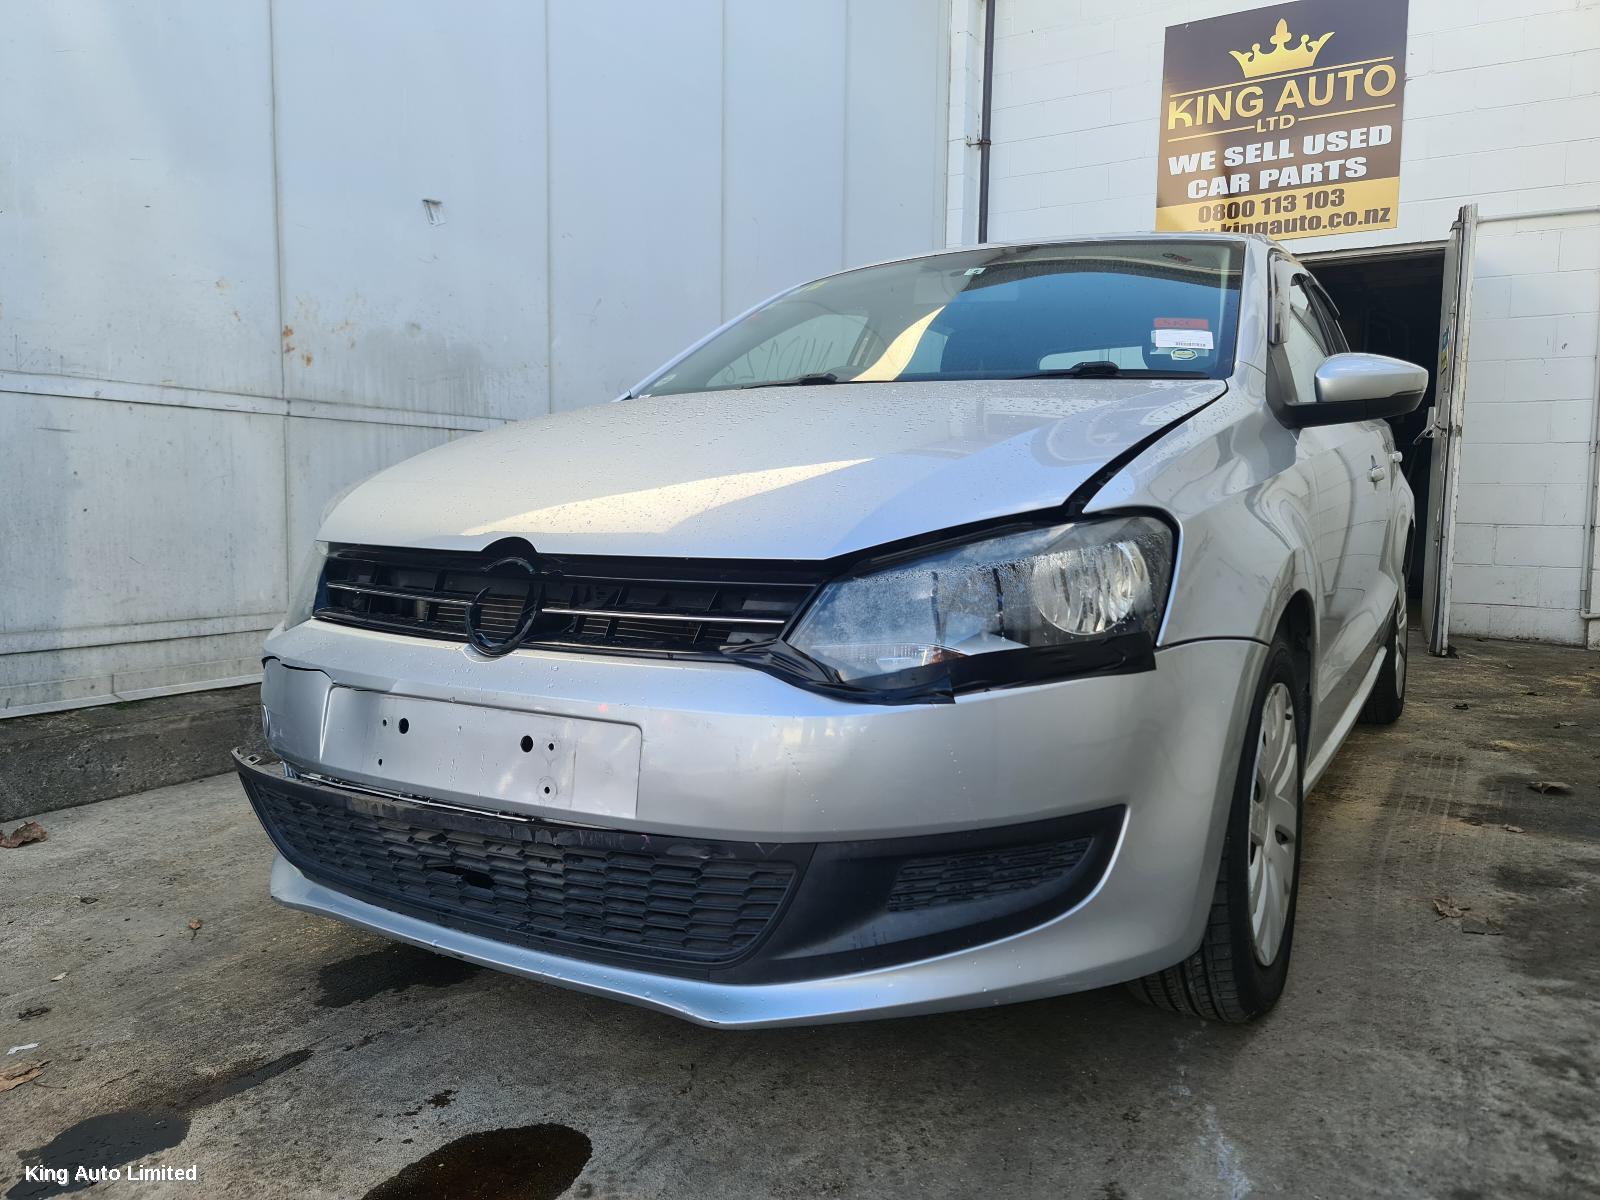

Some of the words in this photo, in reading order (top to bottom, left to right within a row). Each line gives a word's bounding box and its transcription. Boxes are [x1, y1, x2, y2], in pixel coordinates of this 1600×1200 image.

[1167, 86, 1264, 130] KING
[1274, 64, 1397, 113] AUTO
[1256, 114, 1295, 133] LTD
[1167, 150, 1217, 176] WE
[1223, 138, 1295, 167] SELL
[1302, 124, 1393, 155] USED
[1187, 173, 1251, 199] CAR
[1259, 156, 1367, 190] PARTS
[1198, 199, 1255, 223] 0800
[1260, 194, 1297, 216] 113
[1302, 188, 1345, 211] 103
